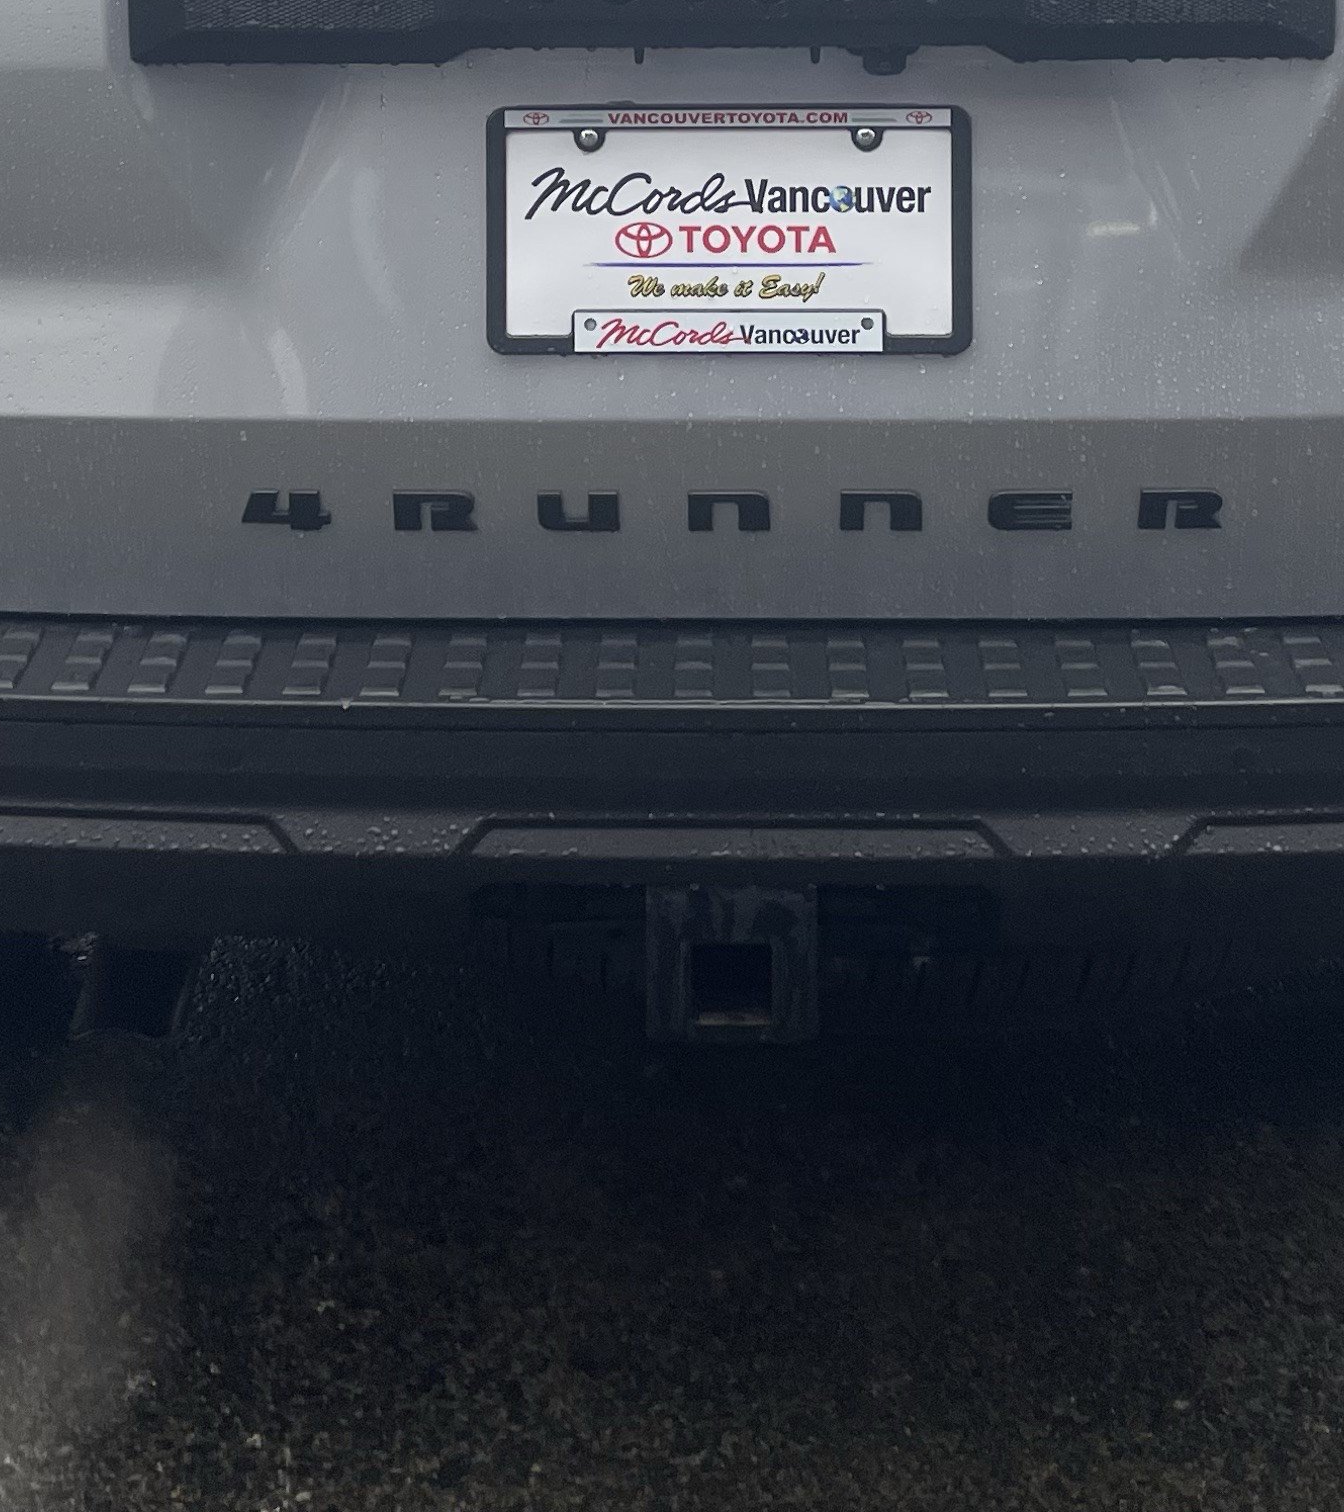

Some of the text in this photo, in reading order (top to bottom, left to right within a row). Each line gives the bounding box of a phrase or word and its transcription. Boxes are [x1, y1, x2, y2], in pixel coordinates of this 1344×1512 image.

[608, 112, 848, 125] VANCOUVERTOYOTA.COM
[524, 167, 932, 220] McCords Vancouver
[678, 224, 837, 254] TOYOTA
[627, 271, 826, 303] We make it Easy!
[595, 317, 860, 349] McCords Vancouver
[240, 489, 1225, 531] 4RUNNER
